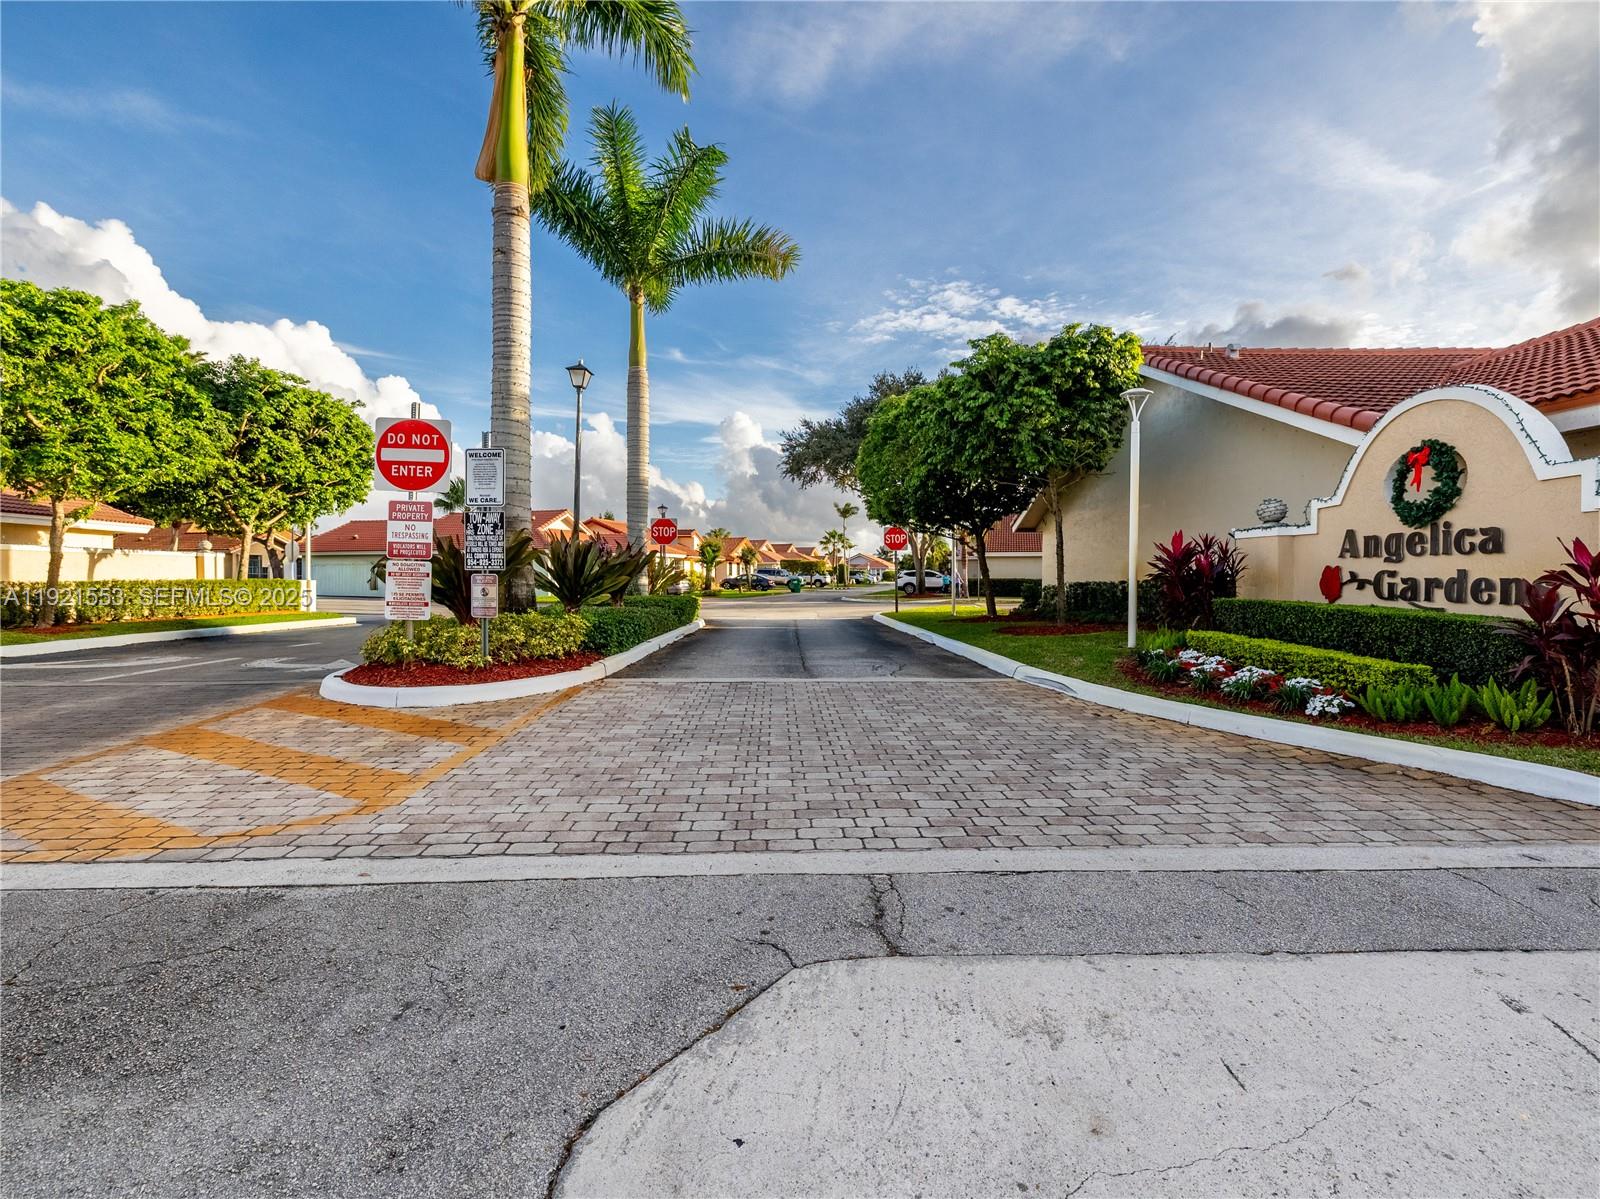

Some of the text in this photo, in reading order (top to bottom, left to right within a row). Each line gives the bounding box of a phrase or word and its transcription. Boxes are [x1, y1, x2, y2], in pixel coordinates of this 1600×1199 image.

[387, 433, 439, 446] DO NOT
[392, 465, 432, 477] ENTER
[396, 504, 424, 512] PRIVATE
[392, 512, 428, 520] PROPERTY
[469, 512, 500, 523] TOW-AWAY
[477, 524, 494, 534] ZONE
[653, 526, 675, 536] STOP
[886, 534, 906, 544] STOP
[1338, 520, 1505, 563] Angelica
[1372, 568, 1530, 606] Garden
